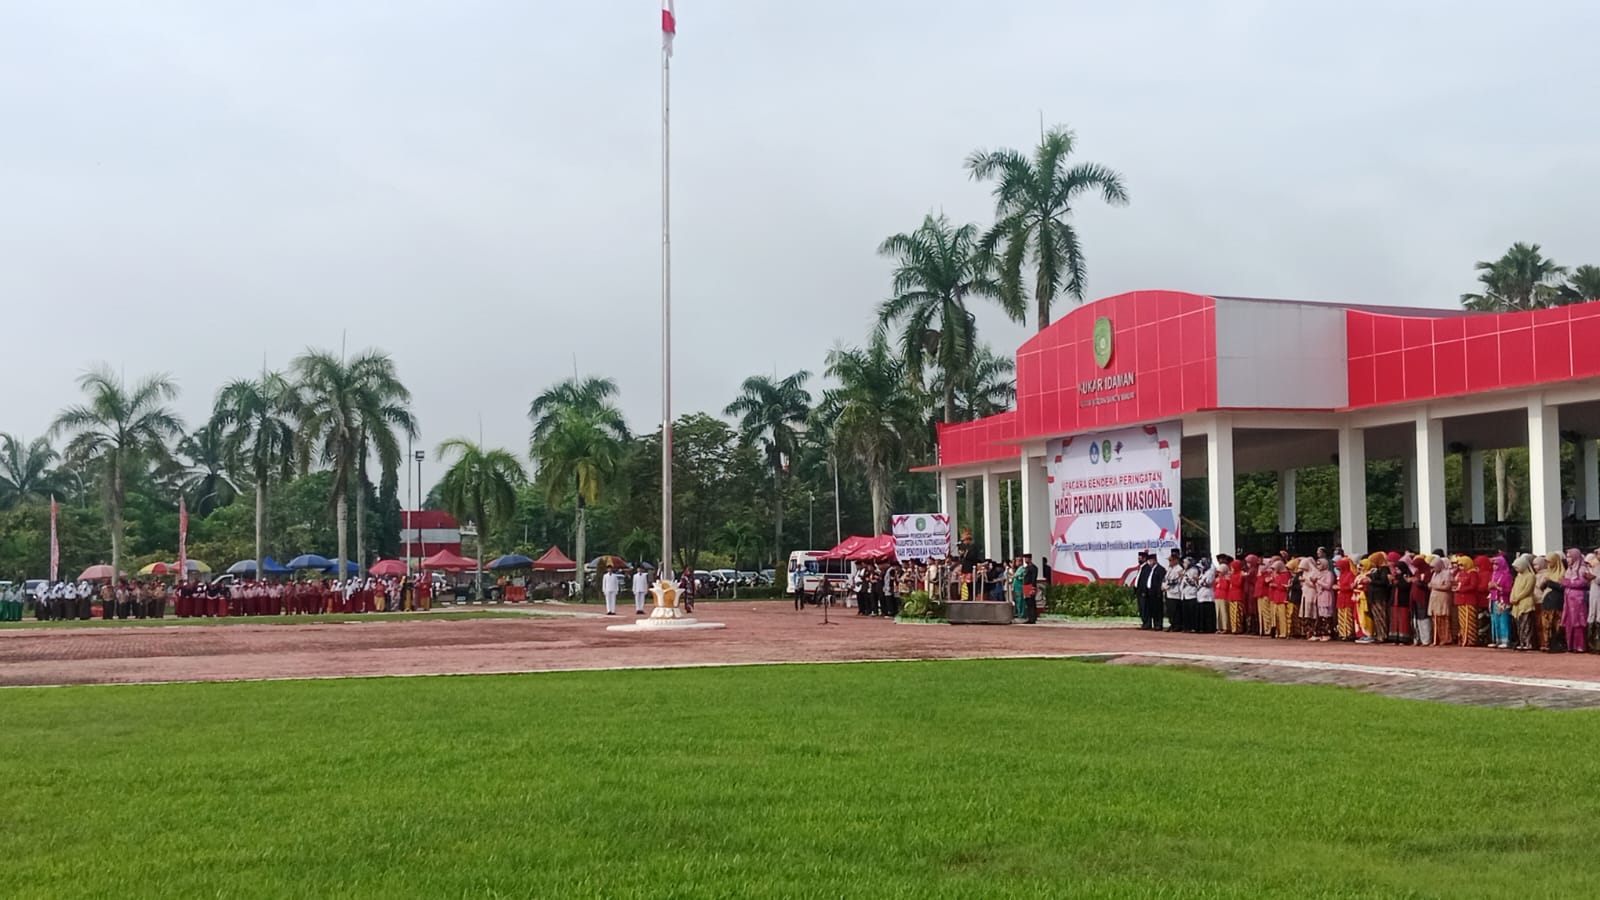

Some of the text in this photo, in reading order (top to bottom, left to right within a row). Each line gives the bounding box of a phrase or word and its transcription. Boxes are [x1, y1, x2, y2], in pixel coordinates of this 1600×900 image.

[1105, 372, 1134, 390] IDAMAN
[1088, 476, 1117, 488] BENDERA
[1120, 471, 1162, 485] PERINGATAN
[1055, 488, 1172, 516] HARI PENDIDIKAN NASIONAL
[1101, 521, 1110, 529] MEI
